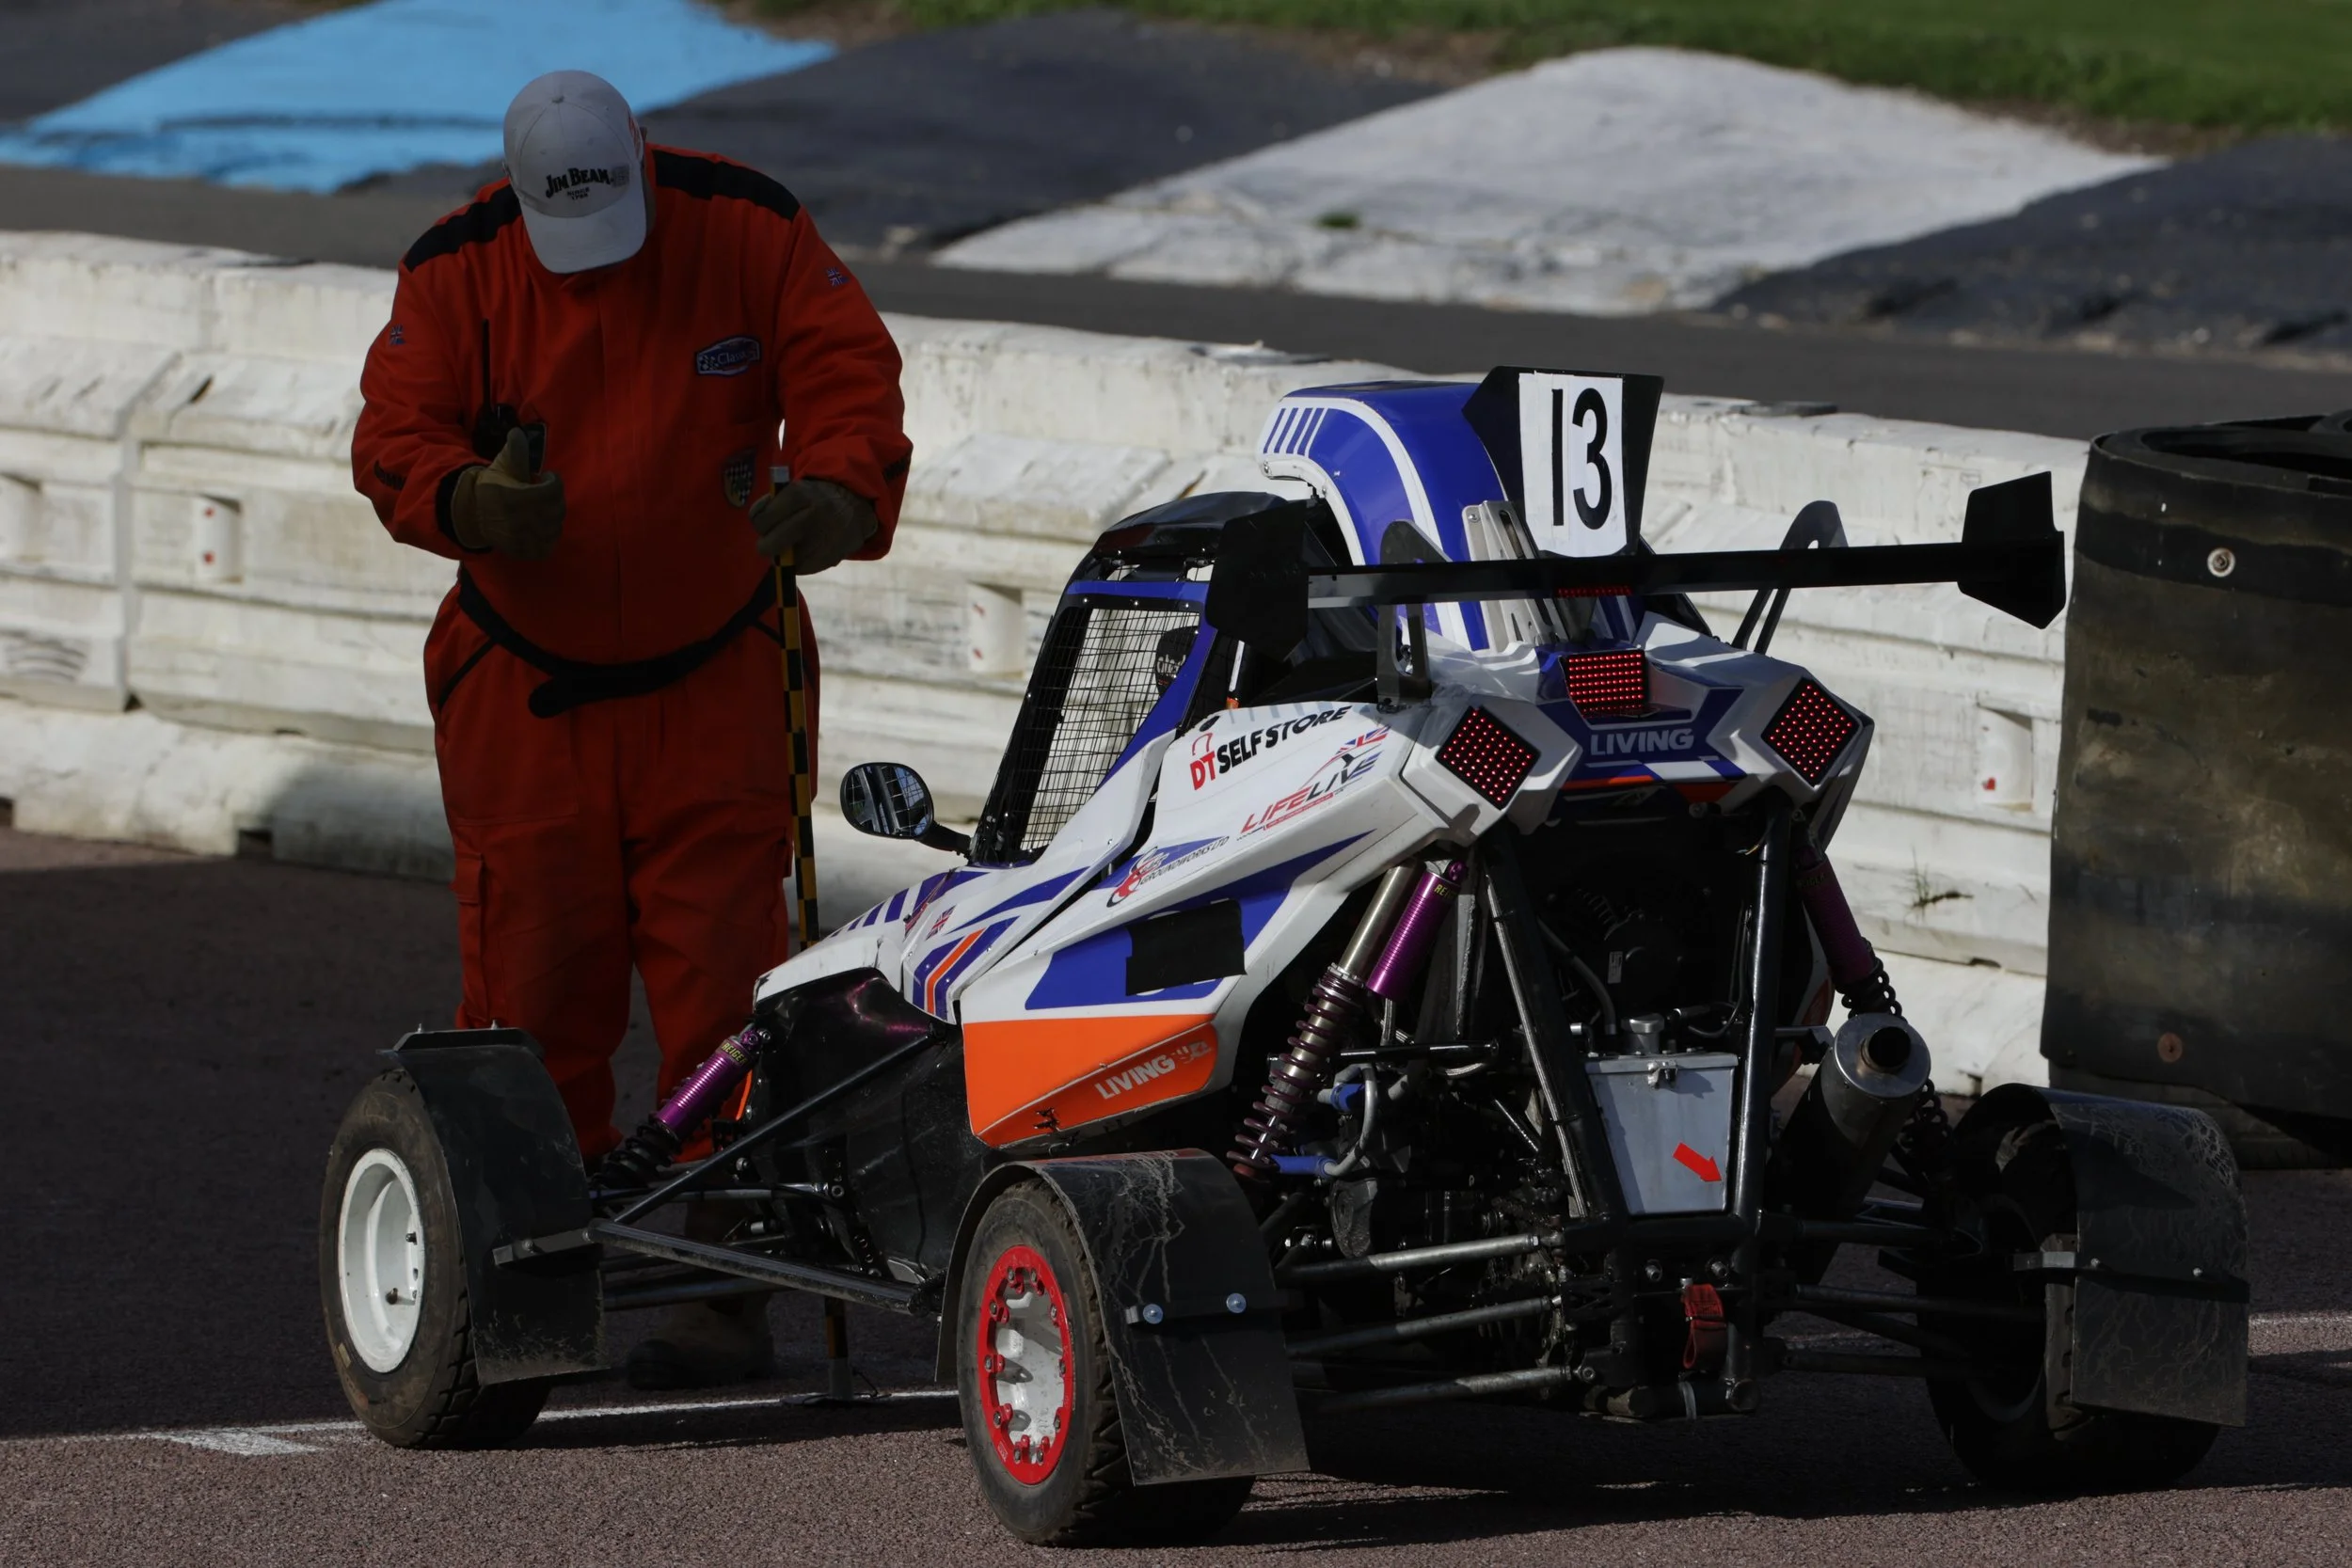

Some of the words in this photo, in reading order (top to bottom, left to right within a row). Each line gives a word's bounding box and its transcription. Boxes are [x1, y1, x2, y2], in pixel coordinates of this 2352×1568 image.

[546, 174, 569, 198] JIM
[568, 167, 611, 186] BEAM
[1552, 388, 1612, 530] 13
[1217, 729, 1263, 774] SELF
[1265, 705, 1353, 749] STORE
[1590, 728, 1694, 755] LIVING
[1094, 1054, 1176, 1100] LIVING
